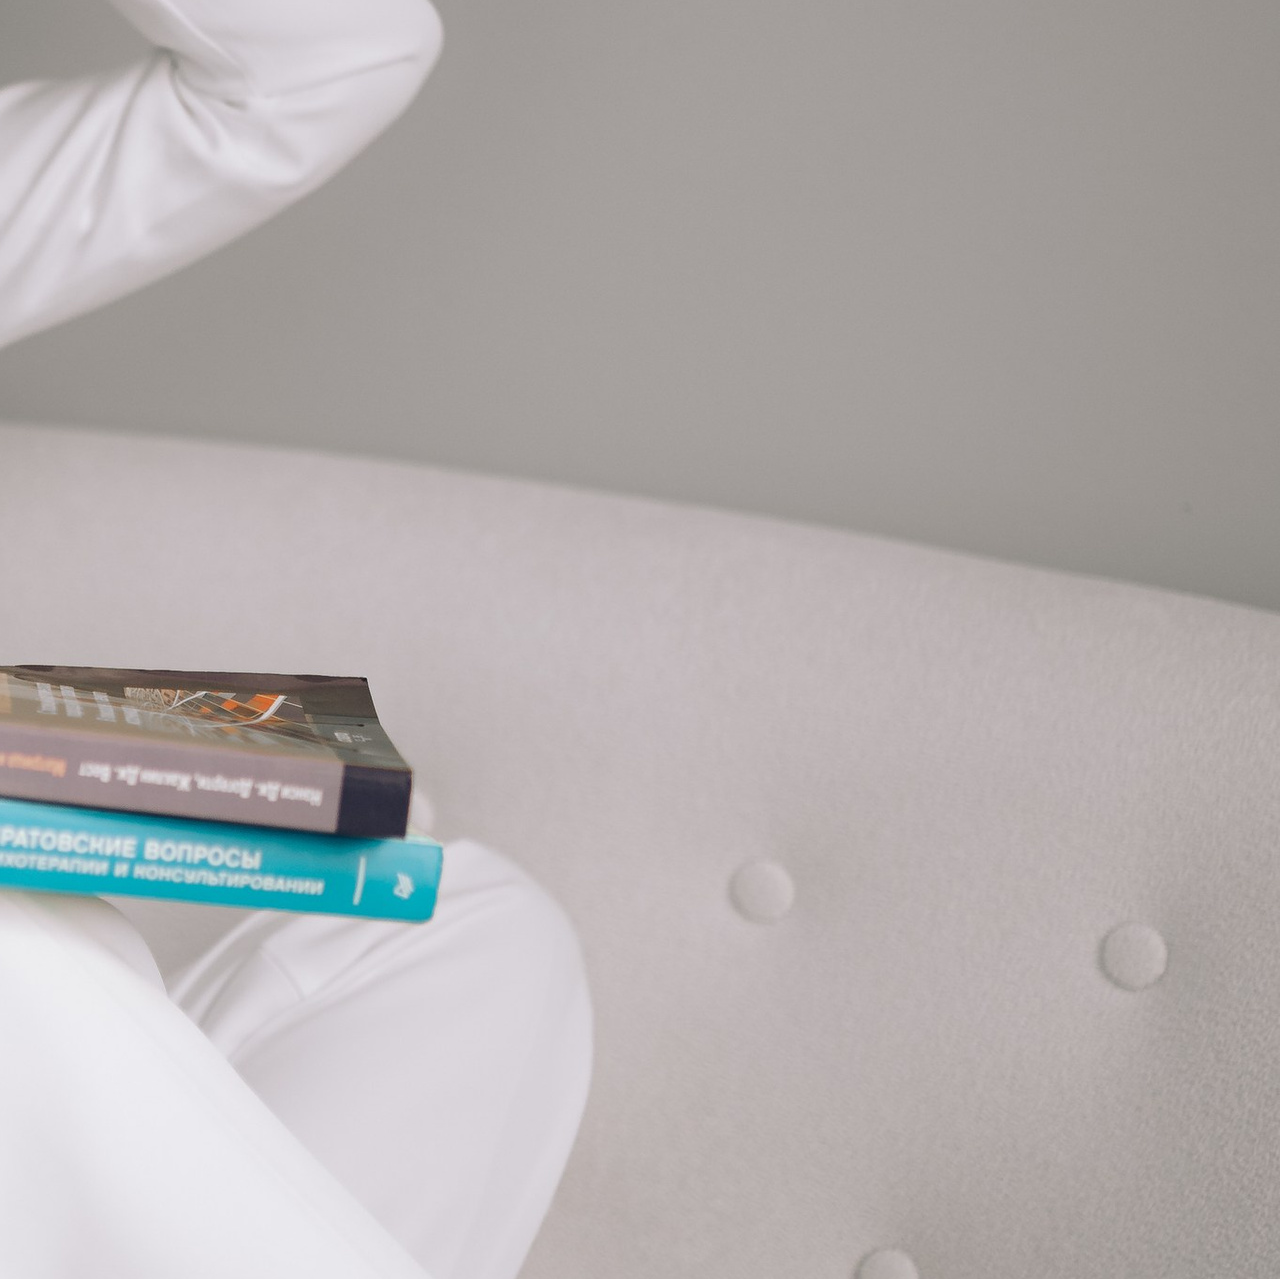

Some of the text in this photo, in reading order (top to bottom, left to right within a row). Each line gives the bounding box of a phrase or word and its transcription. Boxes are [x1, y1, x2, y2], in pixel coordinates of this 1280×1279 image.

[144, 838, 262, 870] ВОПРОСЫ
[113, 862, 131, 879] И
[132, 864, 325, 896] КОНСУЛЬТИРОВАНИИ
